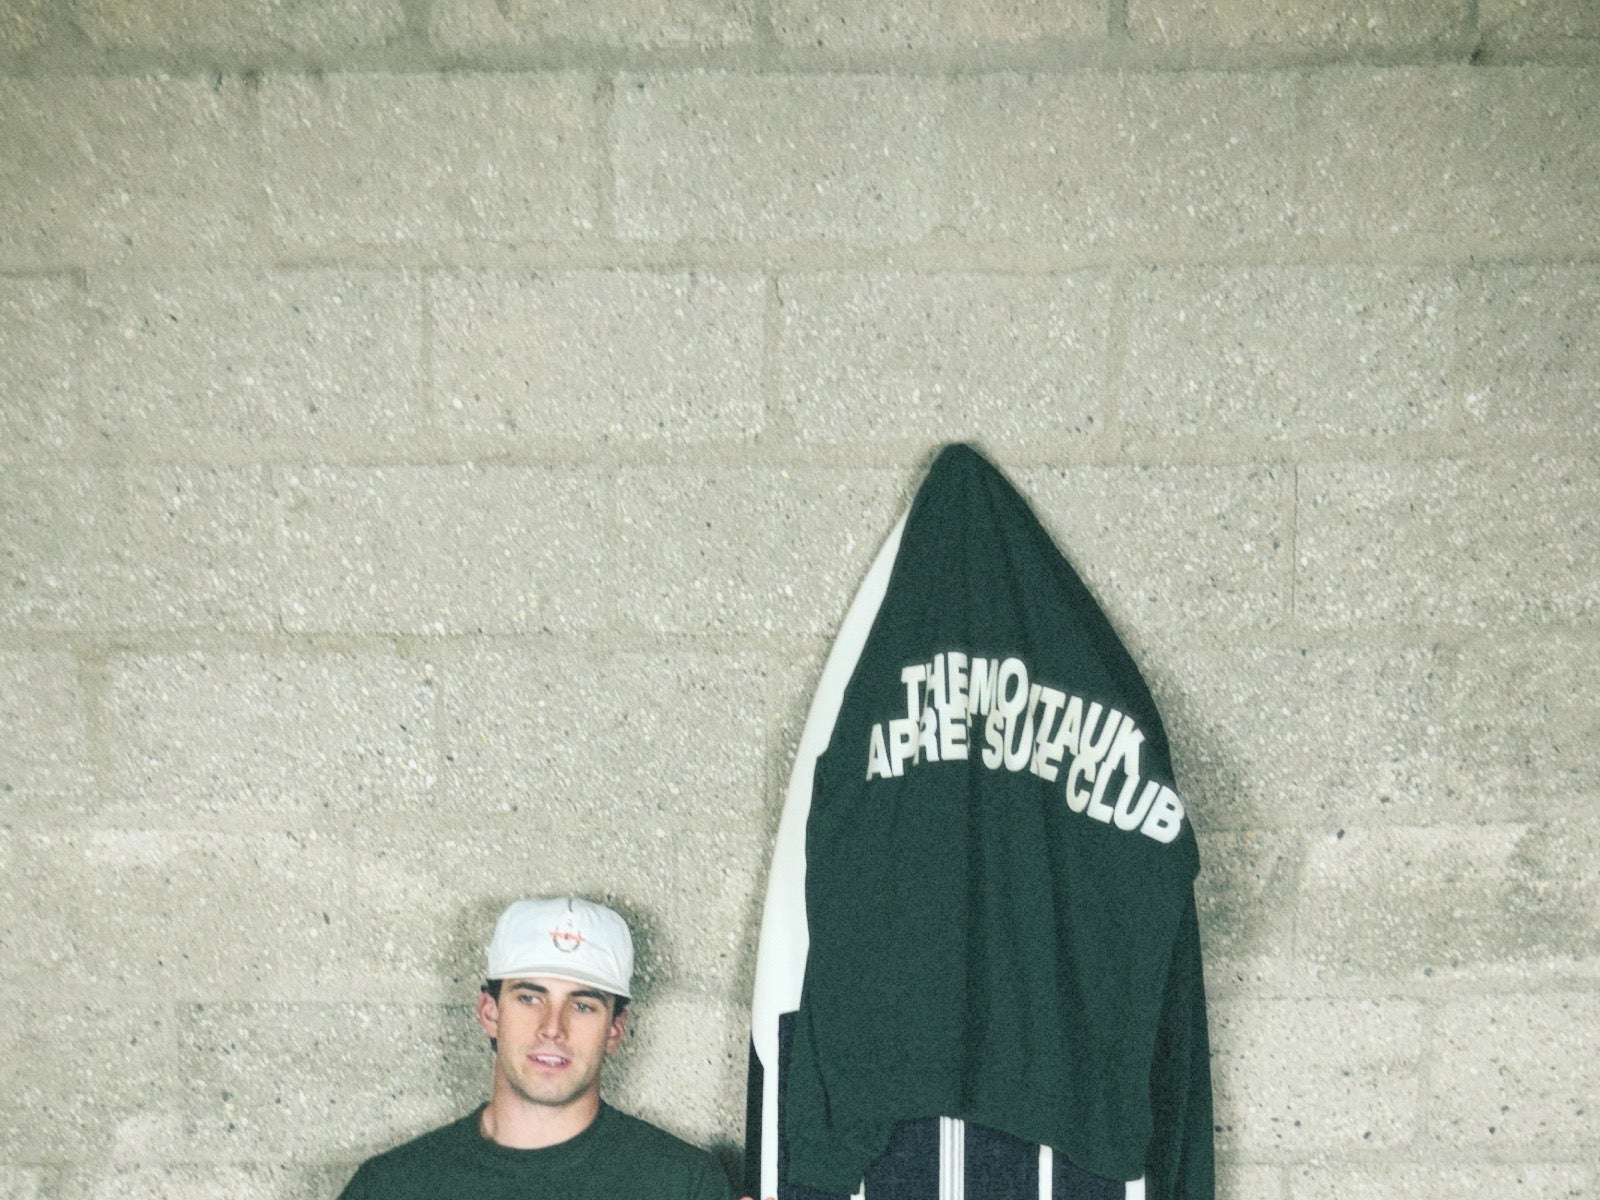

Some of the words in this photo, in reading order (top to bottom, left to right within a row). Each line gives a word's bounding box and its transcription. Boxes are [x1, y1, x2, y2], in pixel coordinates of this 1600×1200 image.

[901, 651, 968, 720] THE
[865, 704, 972, 781] APRE
[1066, 753, 1185, 844] CLUB
